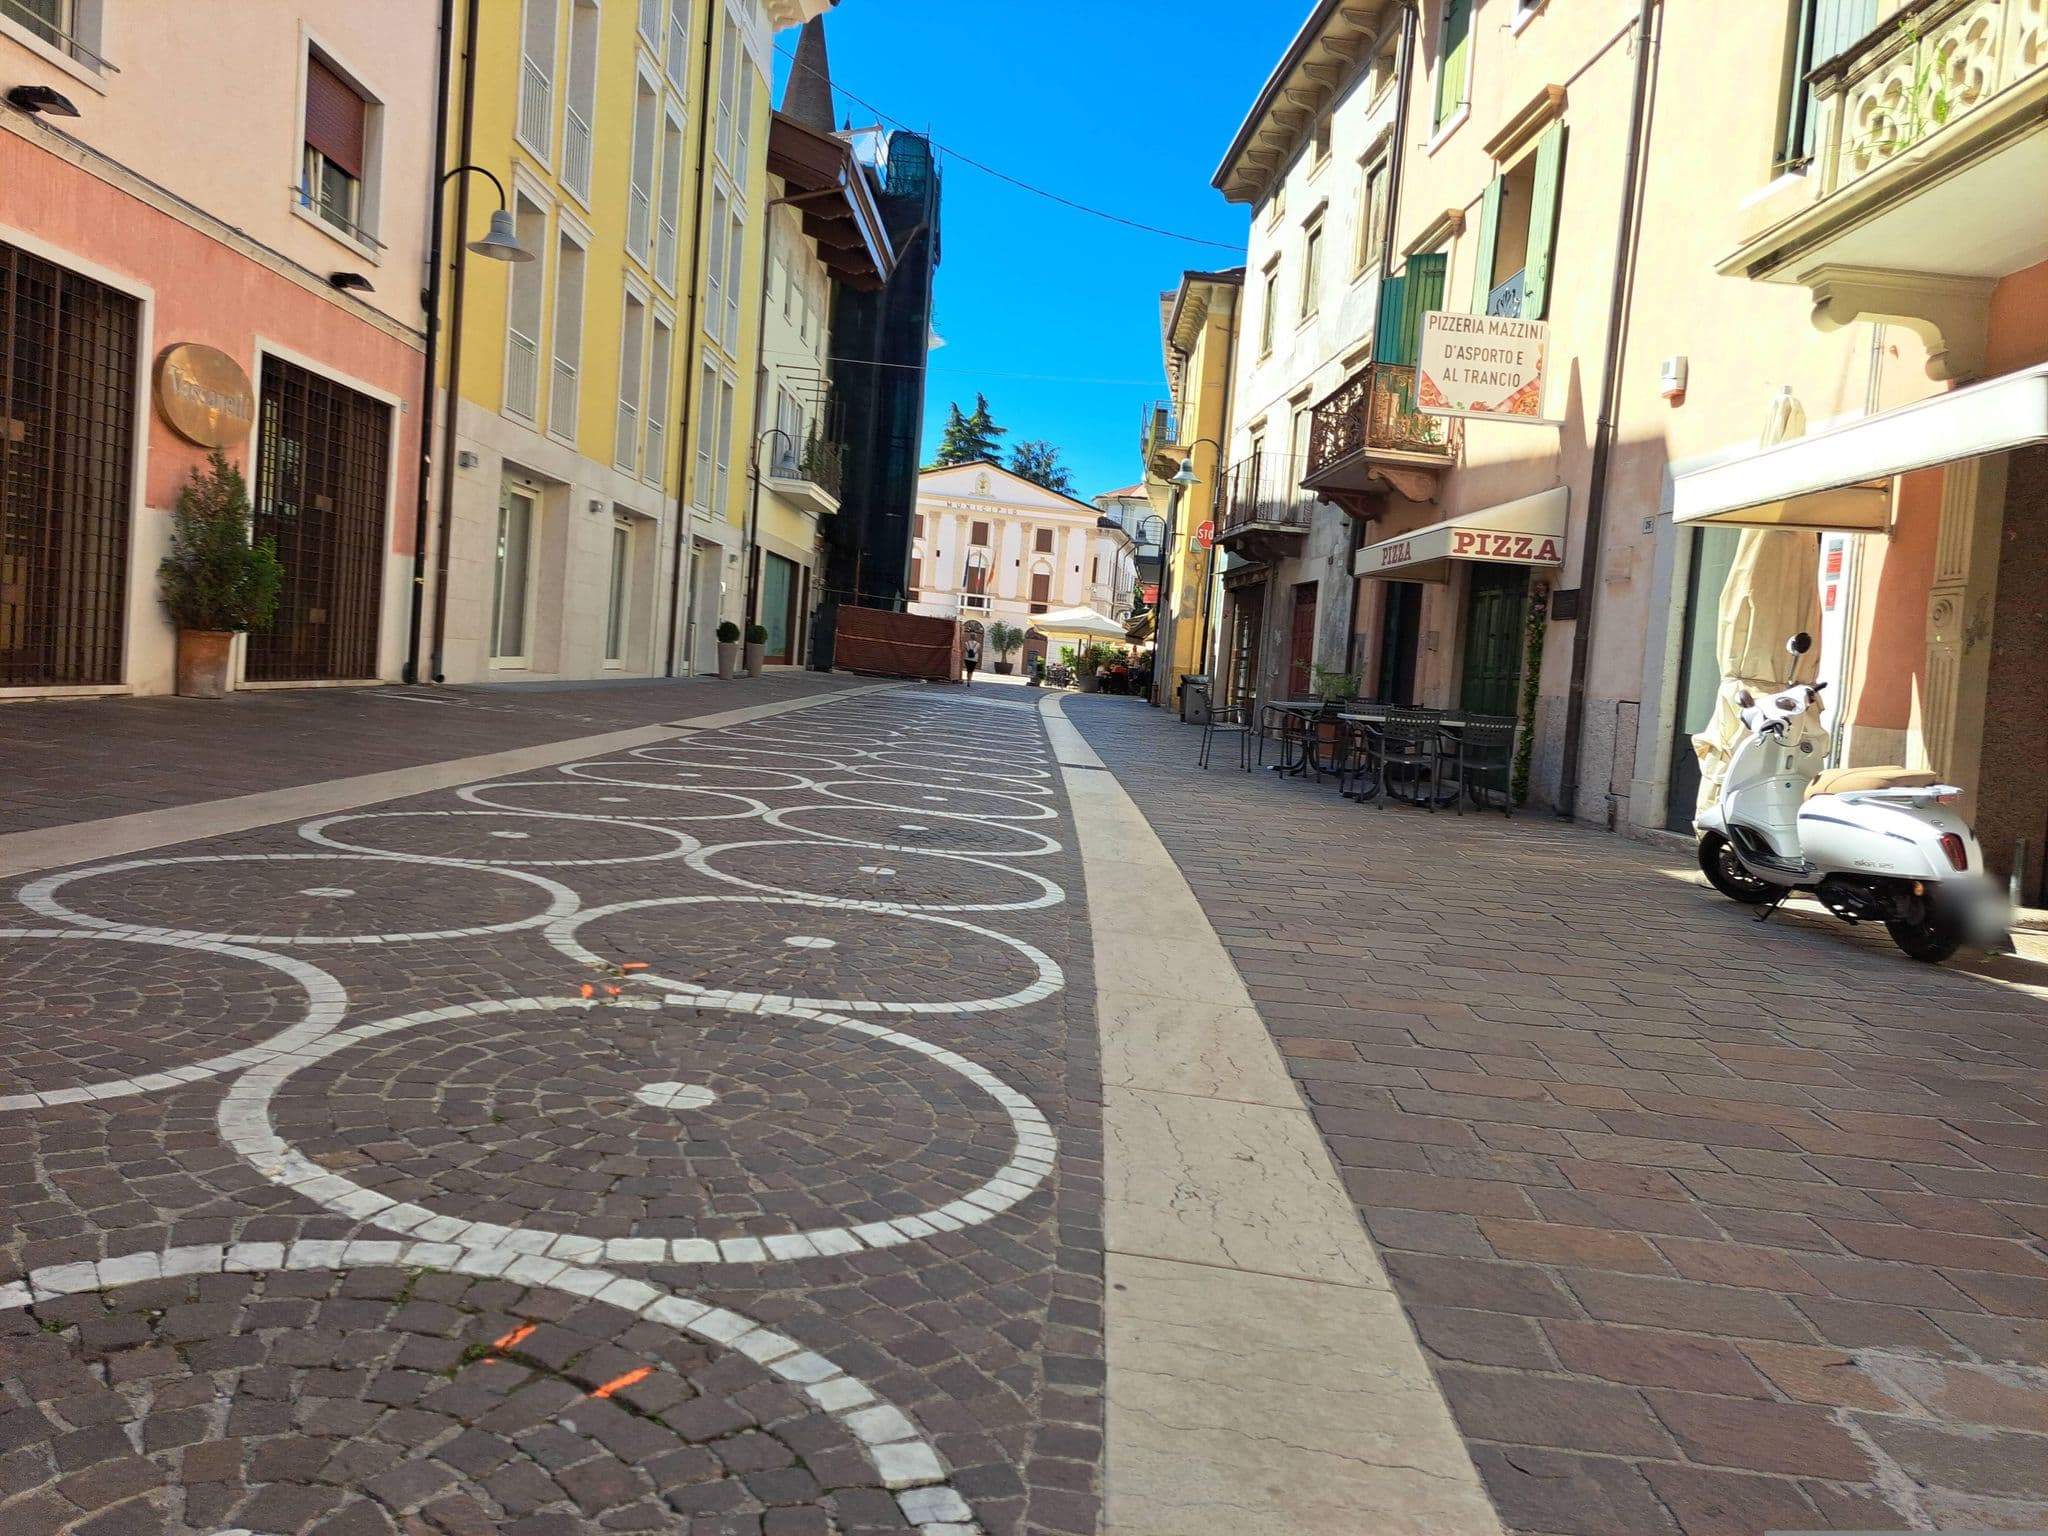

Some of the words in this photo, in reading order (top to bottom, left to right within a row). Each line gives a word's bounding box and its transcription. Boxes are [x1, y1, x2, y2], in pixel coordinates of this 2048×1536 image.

[1428, 314, 1485, 335] PIZZERIA
[1488, 320, 1544, 340] MAZZINI
[1444, 344, 1514, 364] D'ASPORTO
[1516, 351, 1524, 365] E
[1442, 367, 1459, 382] AL
[1463, 368, 1521, 388] TRANCIO
[946, 501, 1018, 516] MUNICIPIO
[1198, 528, 1214, 541] STO
[1381, 541, 1412, 566] PIZZA
[1452, 531, 1562, 562] PIZZA
